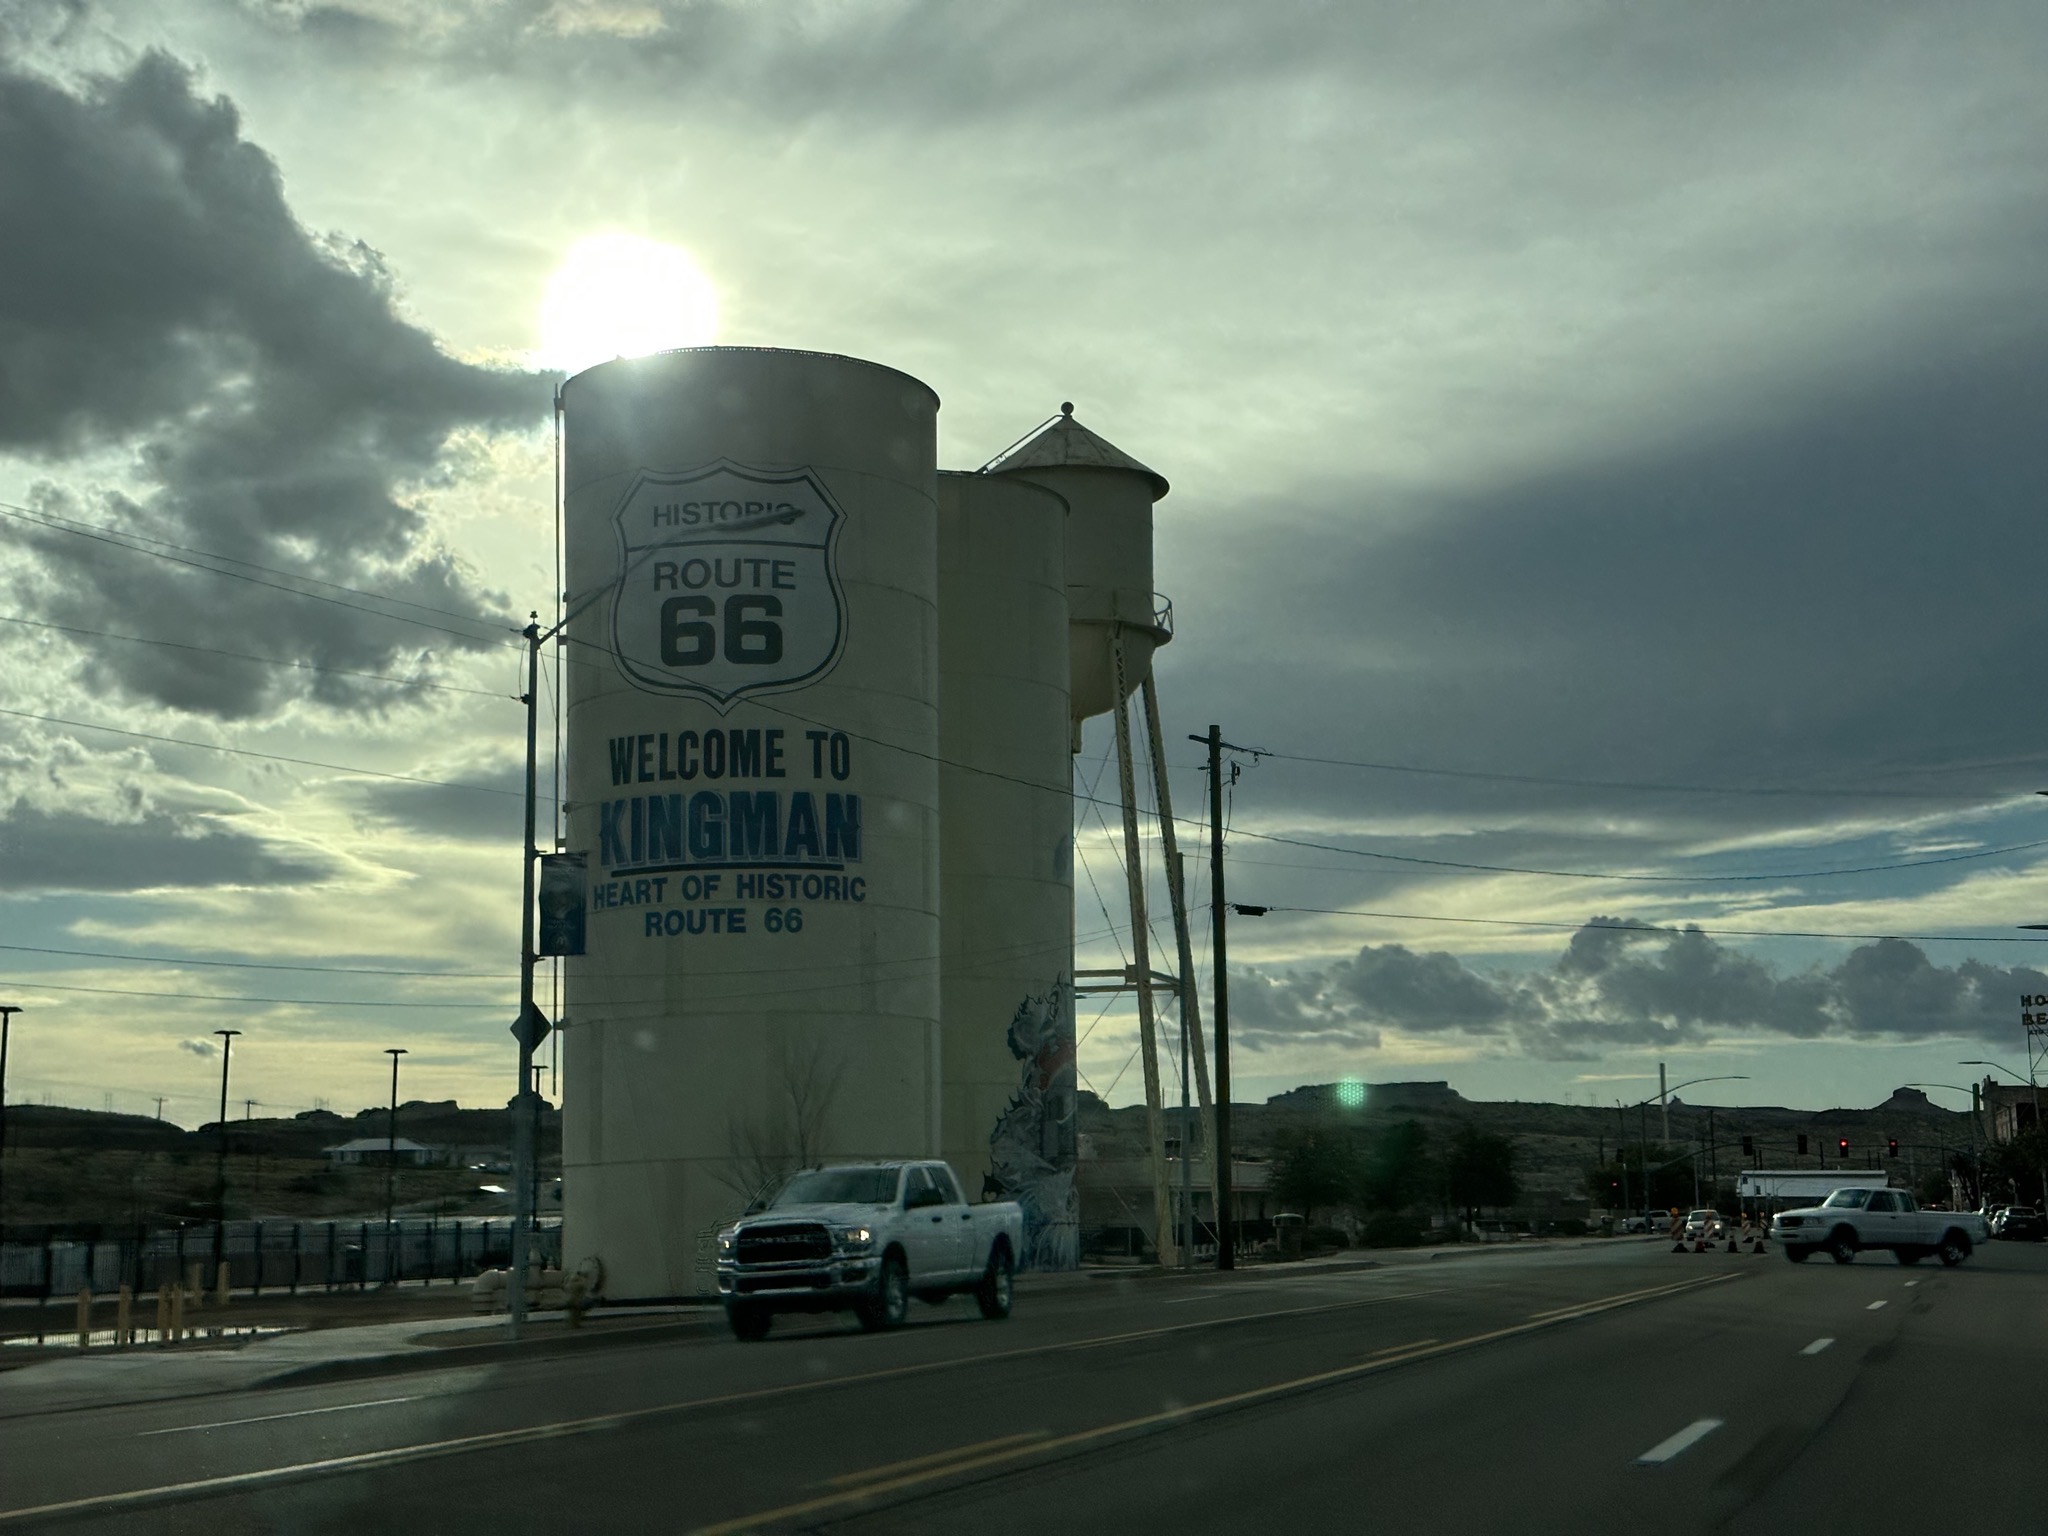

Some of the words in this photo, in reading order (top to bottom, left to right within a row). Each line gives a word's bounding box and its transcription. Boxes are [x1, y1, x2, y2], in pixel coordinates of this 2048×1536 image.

[653, 558, 797, 592] ROUTE
[660, 594, 783, 667] 66
[609, 729, 786, 786] WELCOME
[805, 730, 850, 781] TO
[599, 790, 863, 870] KINGMAN
[593, 877, 668, 910] HEART
[681, 875, 721, 901] OF
[736, 873, 867, 902] HISTORIC
[644, 908, 747, 938] ROUTE
[763, 907, 803, 933] 66
